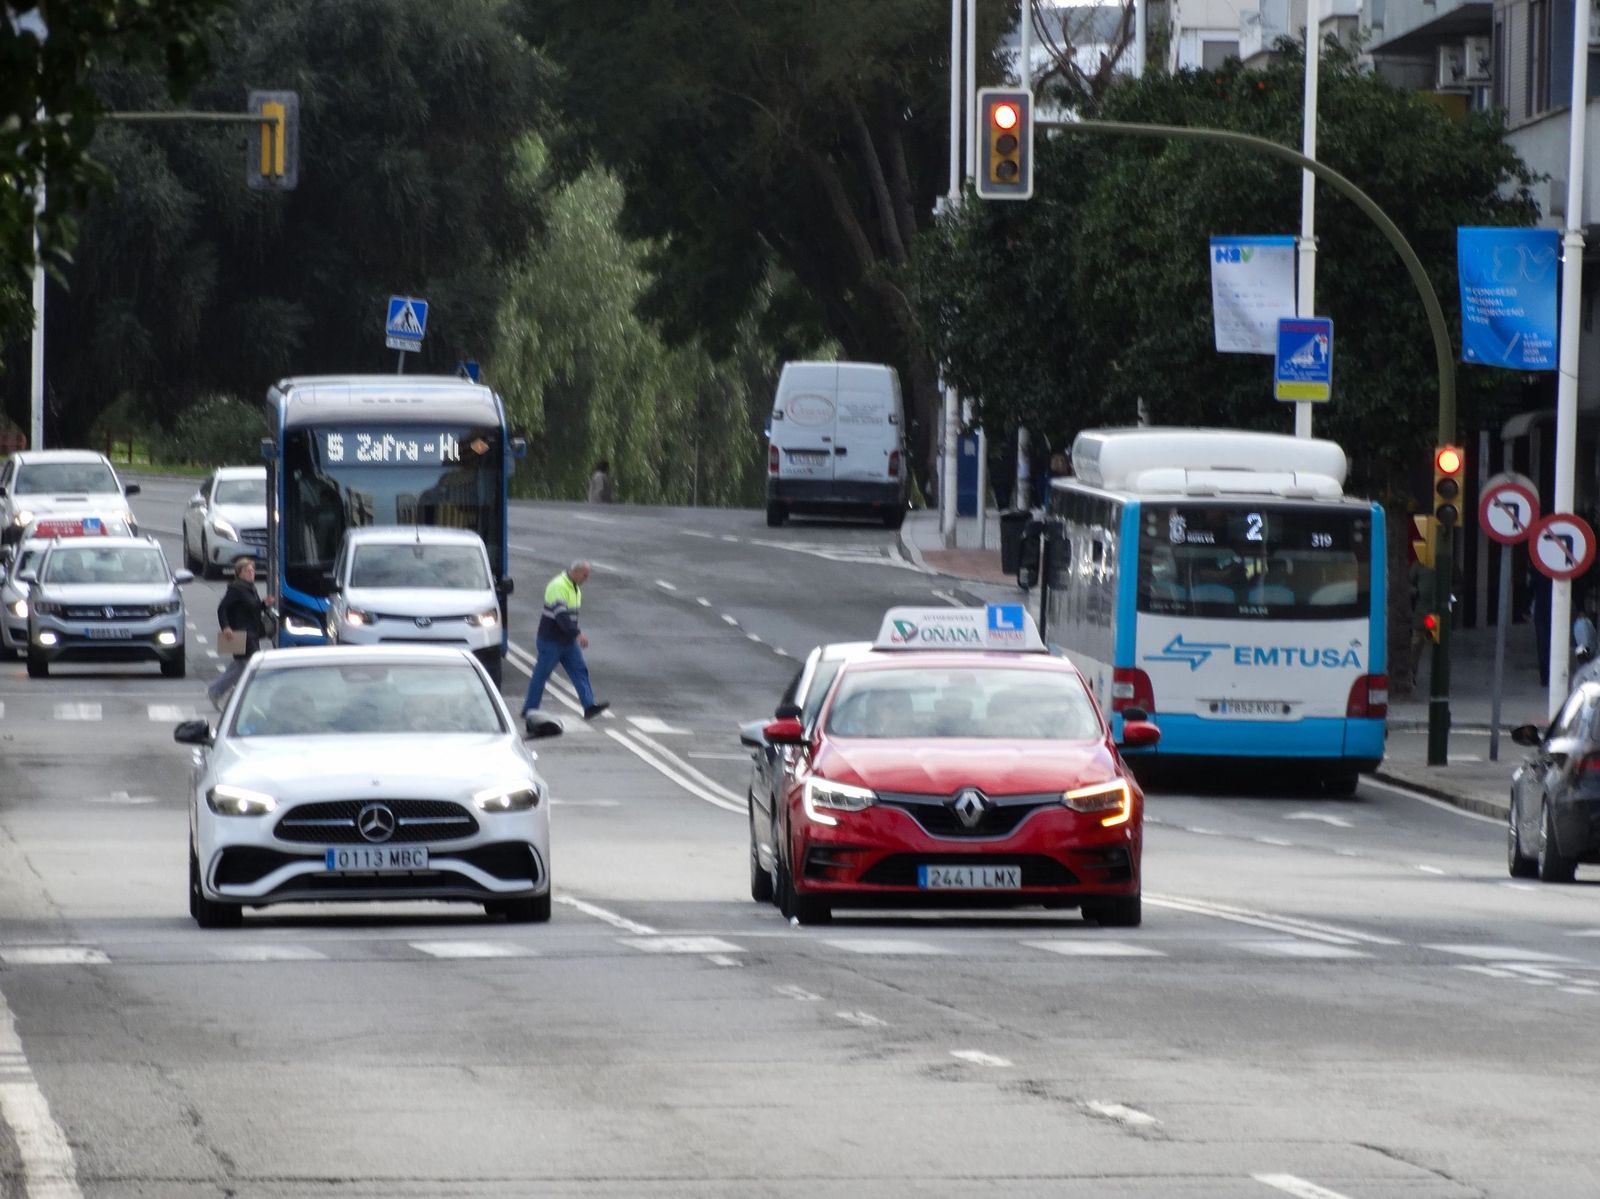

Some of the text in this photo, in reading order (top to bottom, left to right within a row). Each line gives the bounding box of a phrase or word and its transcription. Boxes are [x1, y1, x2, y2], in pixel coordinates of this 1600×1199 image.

[357, 433, 419, 462] Zafra
[1246, 513, 1263, 541] 2
[1311, 532, 1333, 548] 319
[996, 607, 1014, 628] L
[1233, 646, 1362, 669] EMTUSA
[338, 850, 424, 868] 0113 MBC
[930, 869, 1017, 888] 2441 LMX
